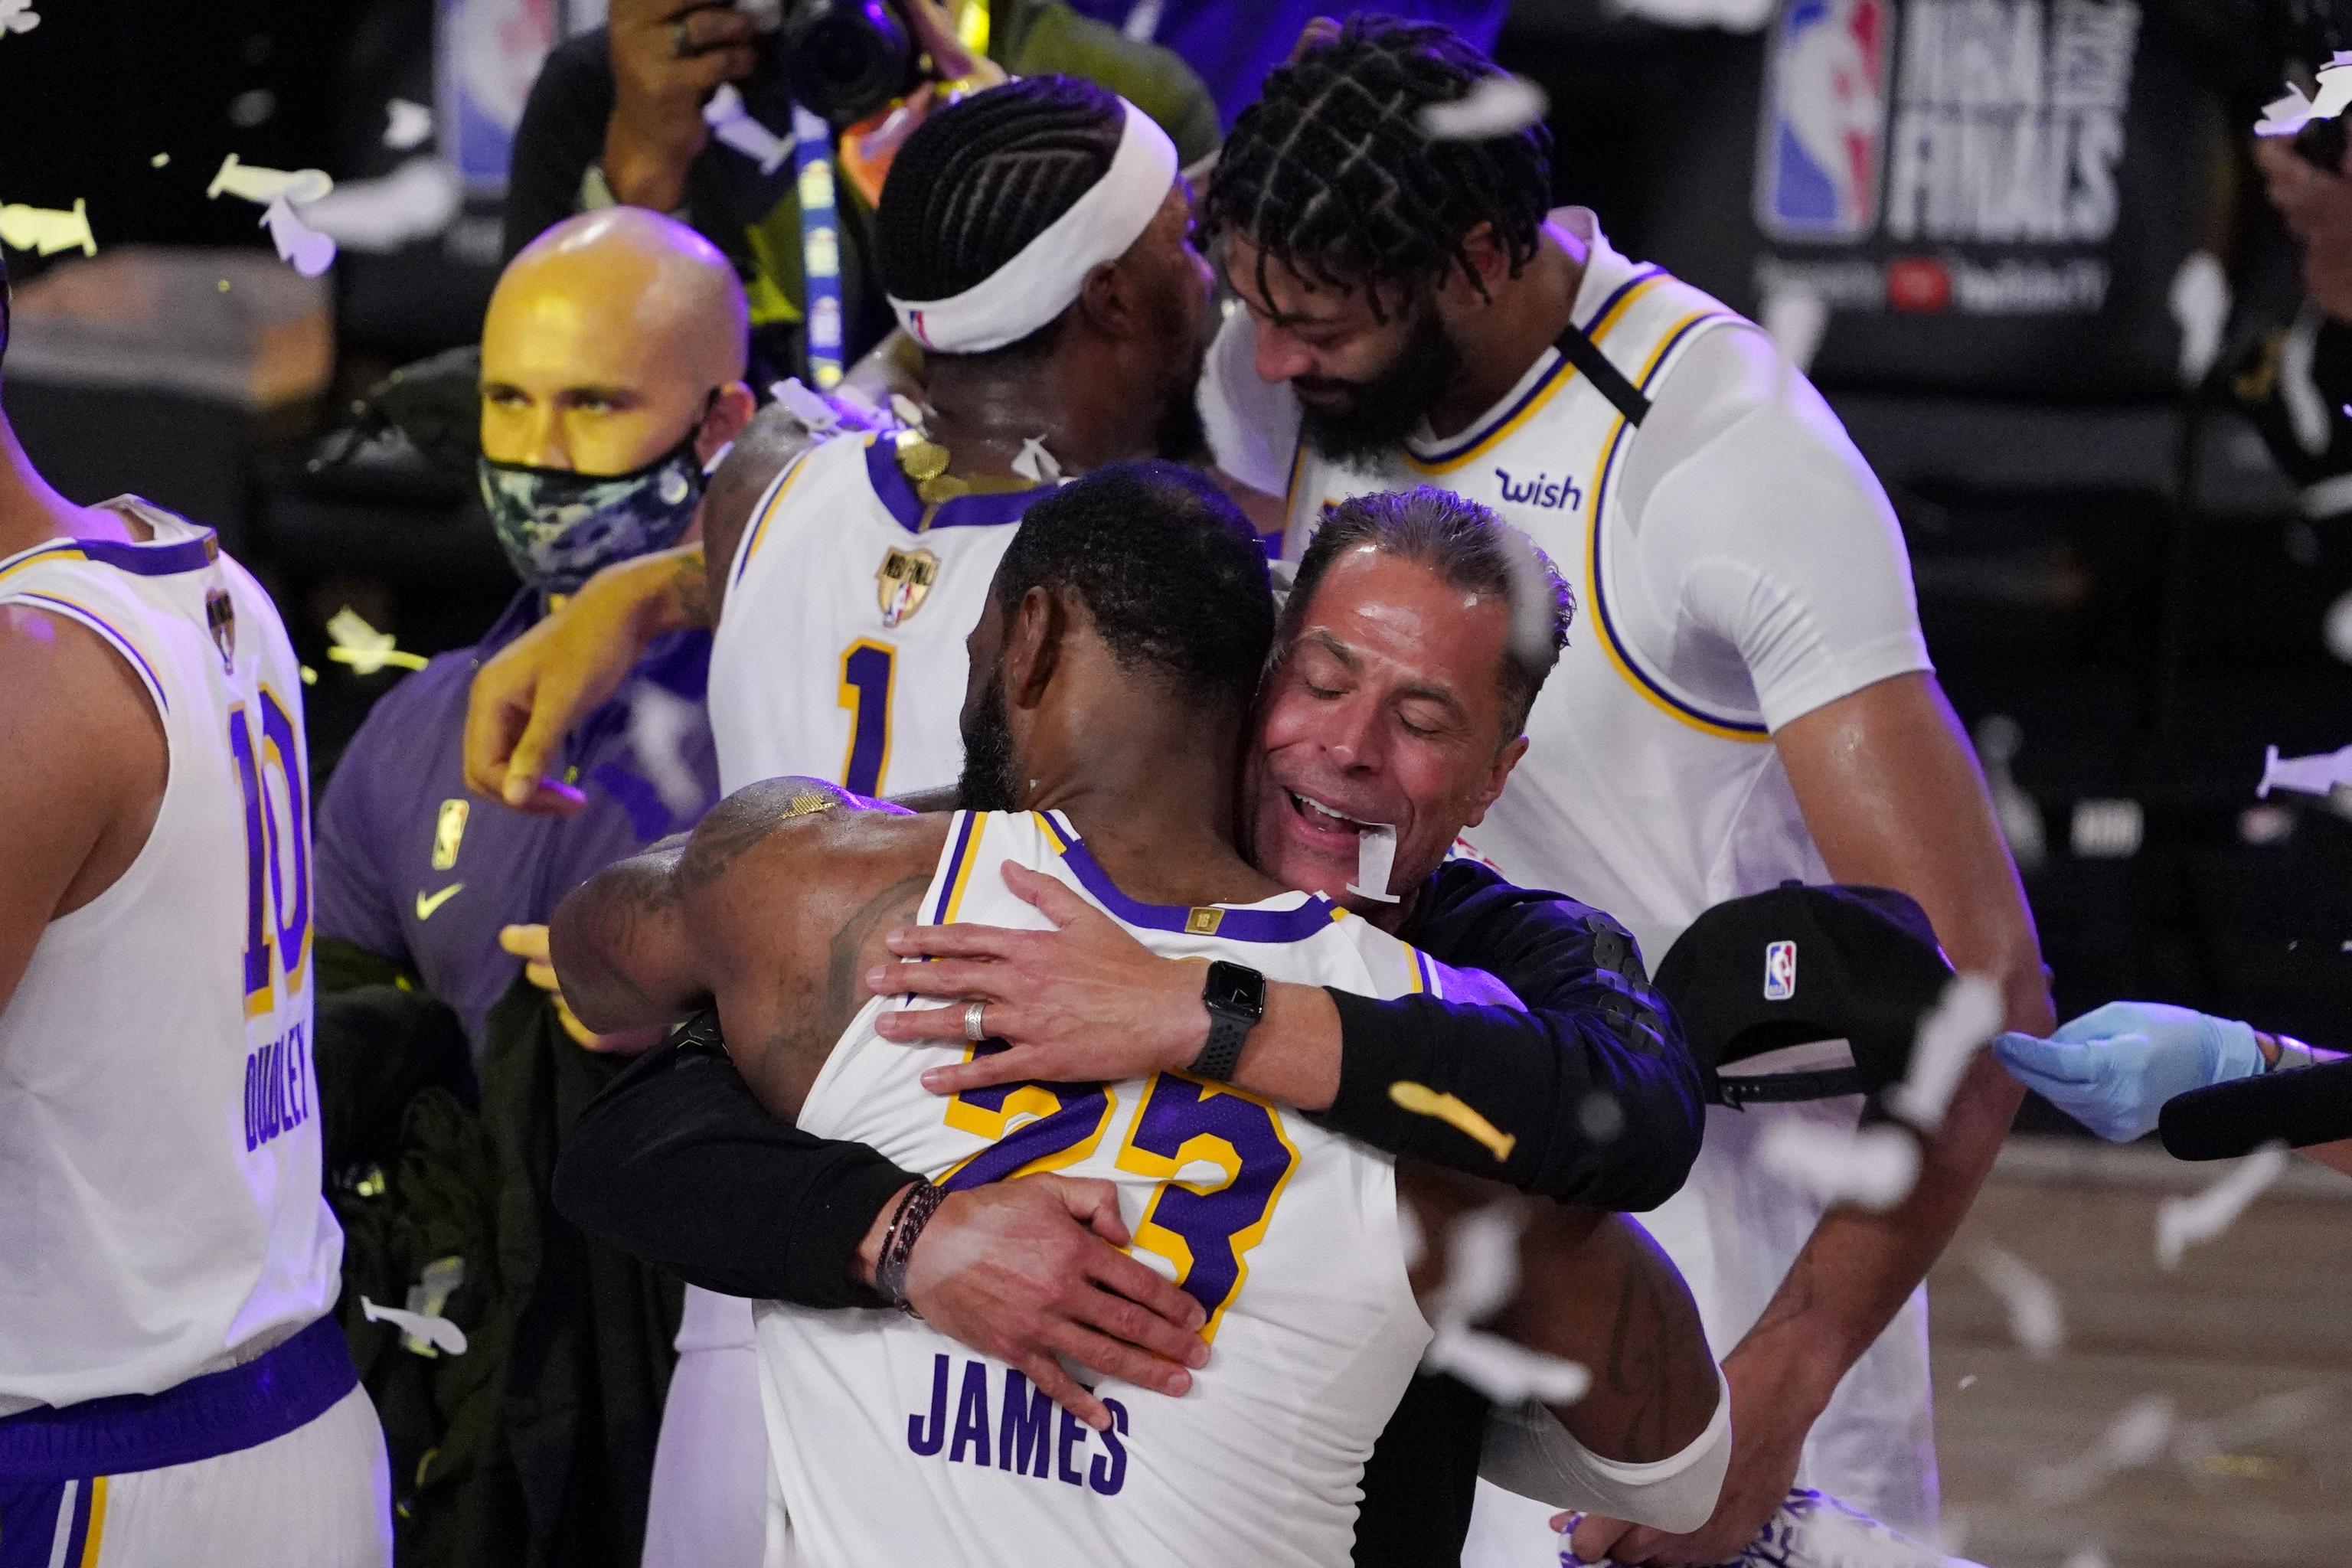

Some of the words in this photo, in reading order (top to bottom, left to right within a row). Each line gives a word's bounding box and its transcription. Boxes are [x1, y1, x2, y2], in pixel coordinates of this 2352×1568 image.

[1495, 469, 1581, 511] wish
[229, 681, 312, 1023] 10
[243, 1023, 307, 1152] DUDLEY
[932, 1039, 1302, 1346] 23
[907, 1353, 1129, 1496] JAMES
